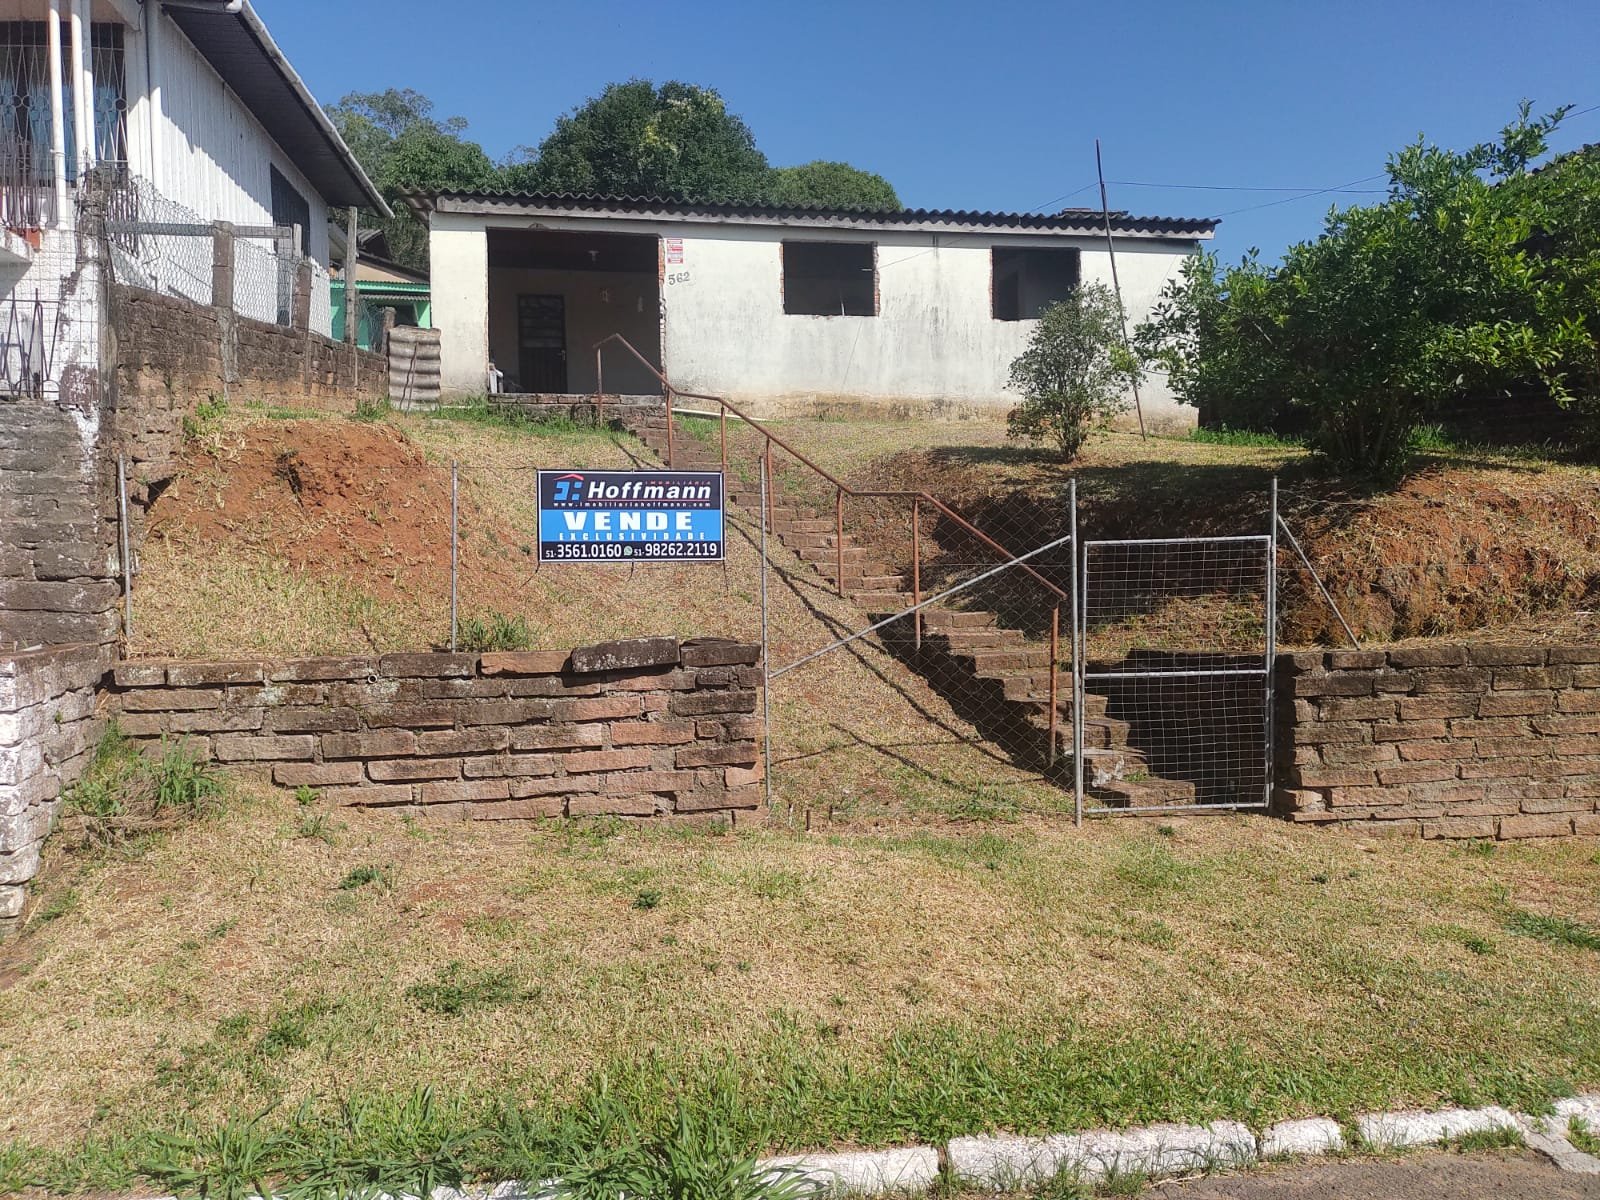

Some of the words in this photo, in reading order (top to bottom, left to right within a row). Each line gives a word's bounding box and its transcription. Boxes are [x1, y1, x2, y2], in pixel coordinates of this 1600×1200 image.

[668, 271, 690, 286] 562
[587, 481, 712, 499] Hoffmann
[563, 511, 693, 531] VENDE
[559, 532, 705, 541] EXCLUSIVIDADE
